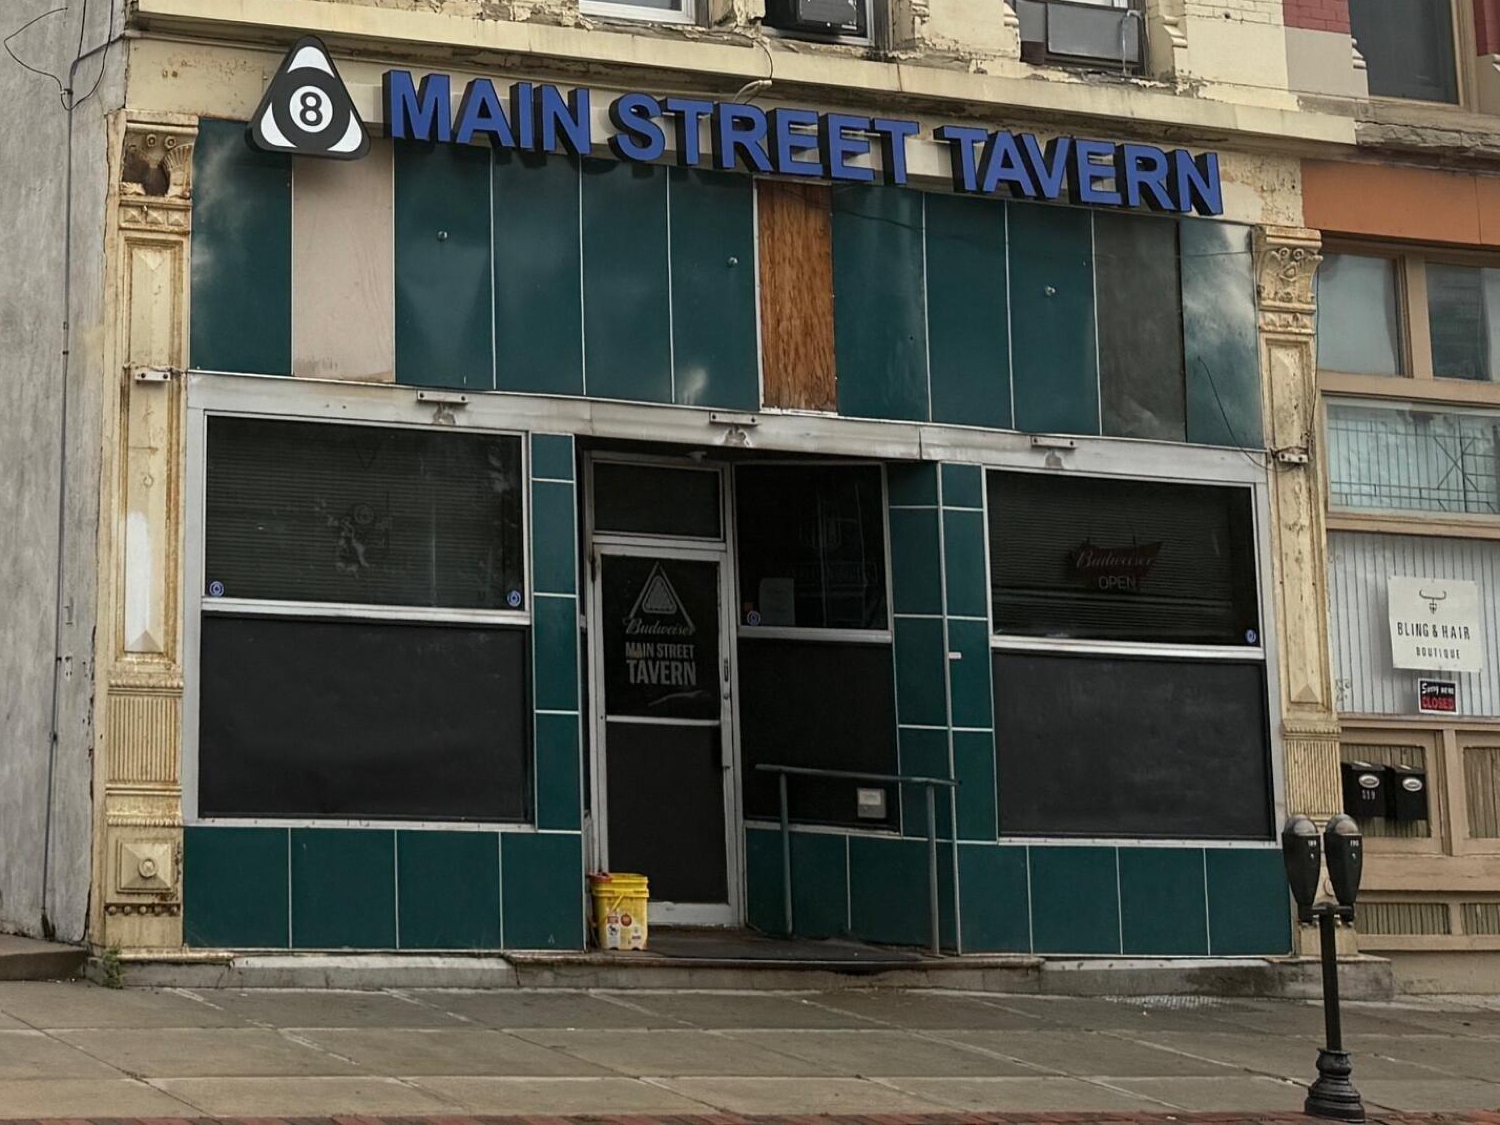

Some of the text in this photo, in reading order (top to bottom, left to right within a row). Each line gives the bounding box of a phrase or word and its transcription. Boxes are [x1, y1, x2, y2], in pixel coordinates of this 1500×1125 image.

[300, 91, 321, 127] 8
[383, 69, 1225, 216] MAIN STREET TAVERN
[1098, 575, 1137, 590] OPEN
[621, 616, 694, 635] Budweiser
[1397, 621, 1471, 640] BLING & HAIR
[625, 641, 695, 660] MAIN STREET
[1415, 646, 1461, 660] BOUTIQUE
[626, 659, 698, 686] TAVERN
[1422, 697, 1455, 710] CLOSED
